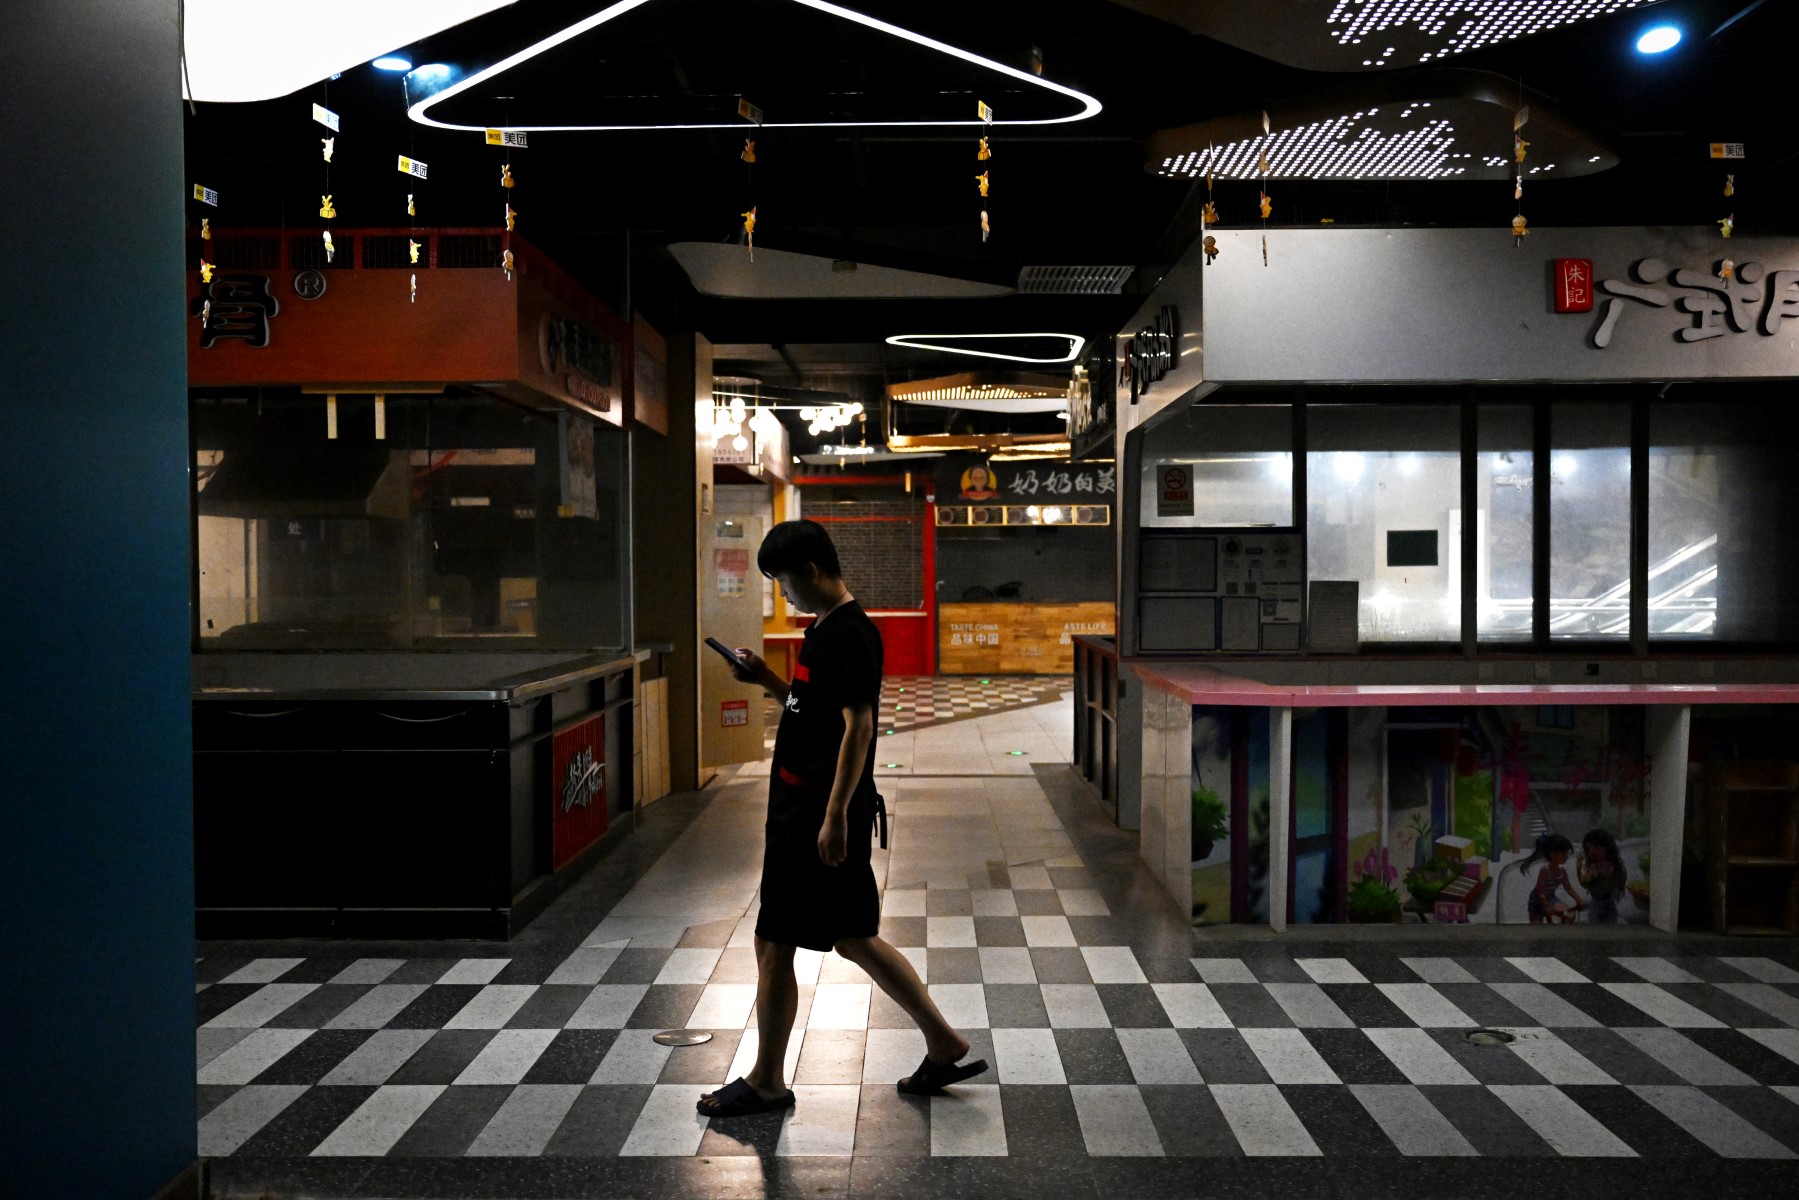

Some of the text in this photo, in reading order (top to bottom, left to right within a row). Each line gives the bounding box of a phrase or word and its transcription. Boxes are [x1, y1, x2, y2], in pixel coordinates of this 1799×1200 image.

[504, 132, 528, 146] 美团
[1725, 144, 1745, 156] 美团
[412, 162, 428, 177] 美团
[205, 190, 218, 204] 美团
[1567, 264, 1586, 305] 朱記
[1008, 466, 1115, 496] 奶奶的美
[950, 623, 999, 631] TASTE CHINA
[1088, 622, 1106, 631] LIFE
[951, 633, 999, 646] 品味中国
